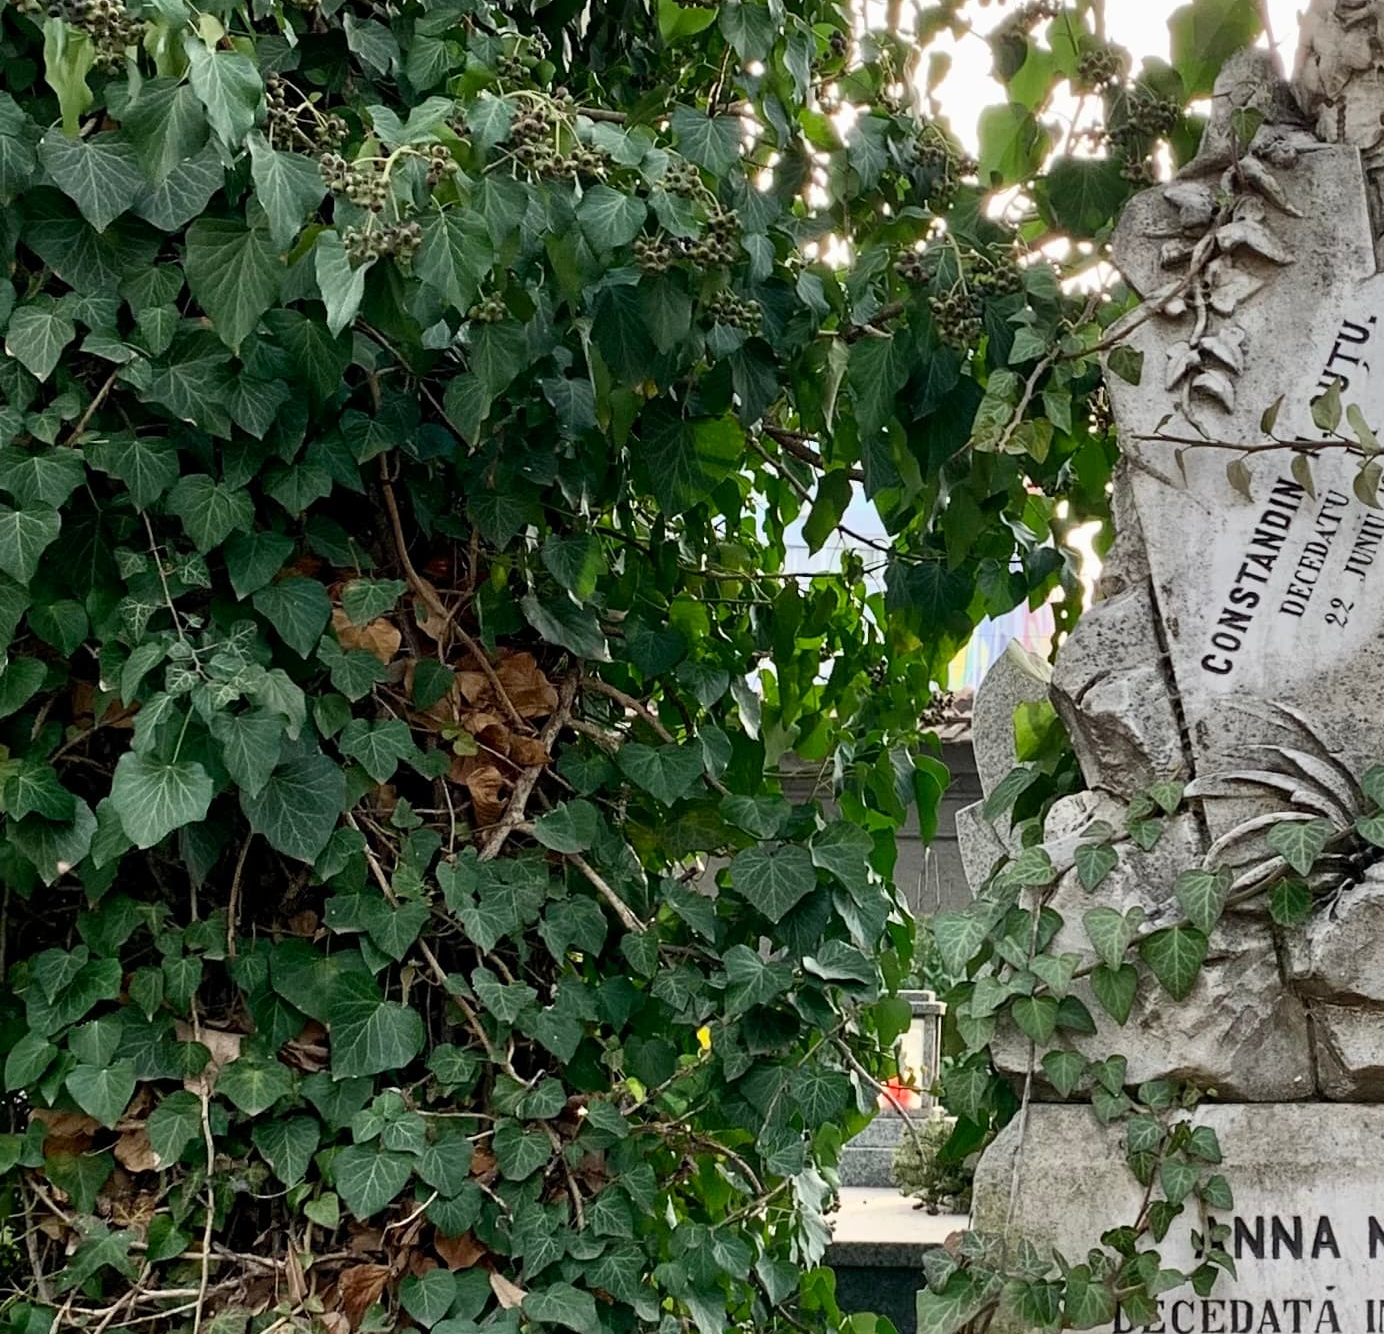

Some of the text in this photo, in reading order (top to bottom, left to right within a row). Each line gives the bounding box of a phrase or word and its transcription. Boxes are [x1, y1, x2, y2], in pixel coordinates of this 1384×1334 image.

[1201, 477, 1306, 676] CONSTANDIN
[1310, 316, 1377, 407] UȚU.
[1324, 597, 1354, 628] 22
